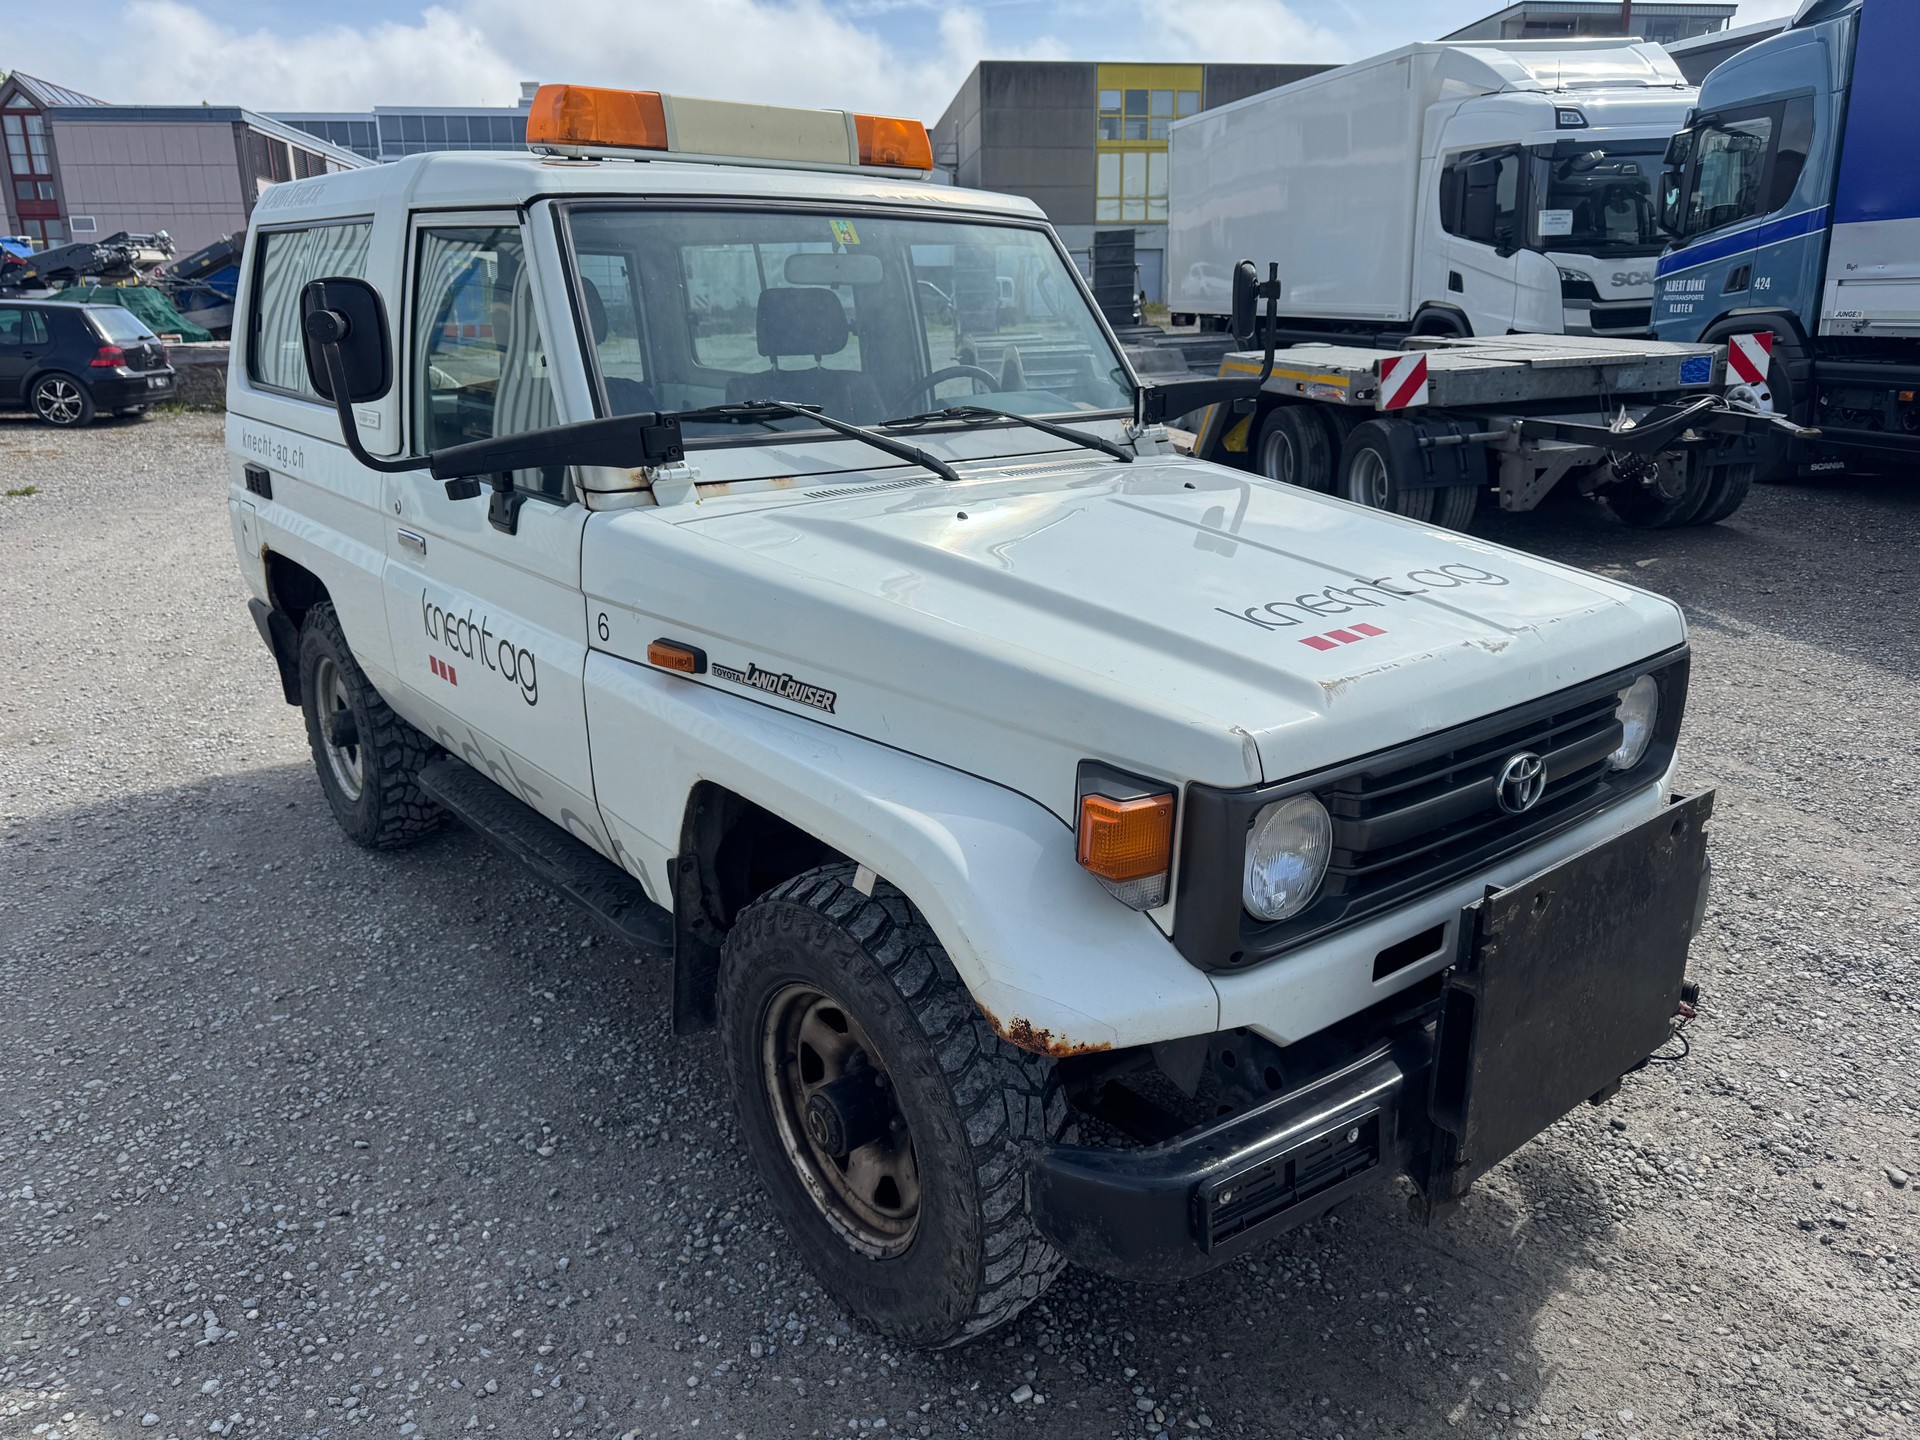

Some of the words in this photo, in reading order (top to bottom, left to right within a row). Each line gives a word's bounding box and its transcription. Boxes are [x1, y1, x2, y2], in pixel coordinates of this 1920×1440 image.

[1611, 271, 1653, 287] SCA
[1664, 280, 1686, 292] ALBERT
[1754, 277, 1771, 290] 424
[1669, 303, 1694, 313] KLOTEN
[242, 426, 304, 469] knecht-ag.ch
[1810, 461, 1845, 471] SCANIA
[1214, 577, 1429, 632] knecht
[1407, 562, 1510, 588] ag
[598, 612, 610, 642] 6
[422, 588, 496, 671] knecht
[498, 639, 538, 707] ag
[712, 666, 742, 682] TOYOTA
